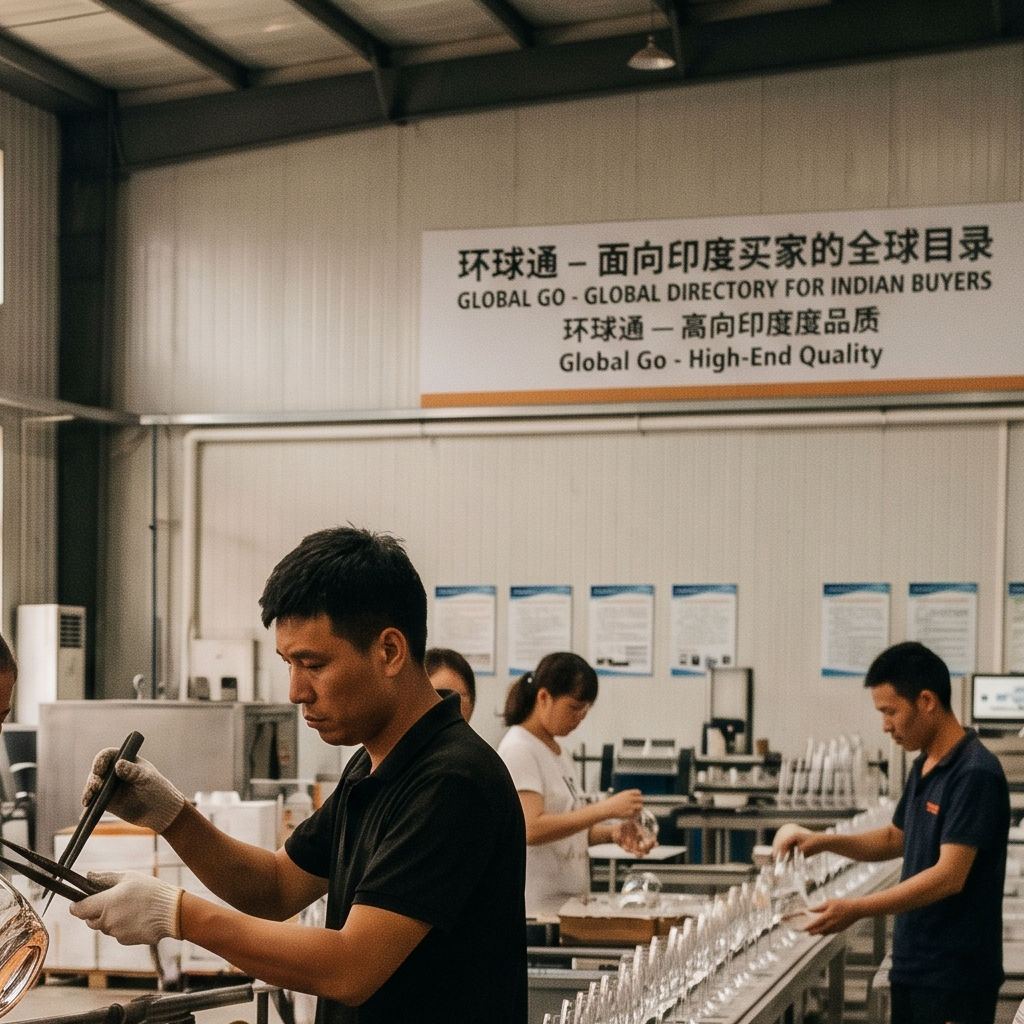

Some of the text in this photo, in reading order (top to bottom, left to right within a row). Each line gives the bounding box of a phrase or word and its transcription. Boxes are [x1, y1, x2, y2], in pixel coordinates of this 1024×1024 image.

[457, 244, 559, 282] 环球通
[597, 224, 994, 278] 面向印度买家的全球目录
[457, 289, 532, 310] GLOBAL
[537, 287, 566, 307] GO
[583, 283, 662, 306] GLOBAL
[666, 279, 779, 302] DIRECTORY
[784, 277, 825, 298] FOR
[830, 274, 905, 296] INDIAN
[911, 269, 993, 294] BUYERS
[562, 314, 645, 344] 环球通
[681, 305, 881, 341] 高向印度度品质
[558, 350, 630, 374] Global
[636, 350, 668, 371] Go
[688, 344, 792, 374] High-End
[798, 342, 884, 370] Quality
